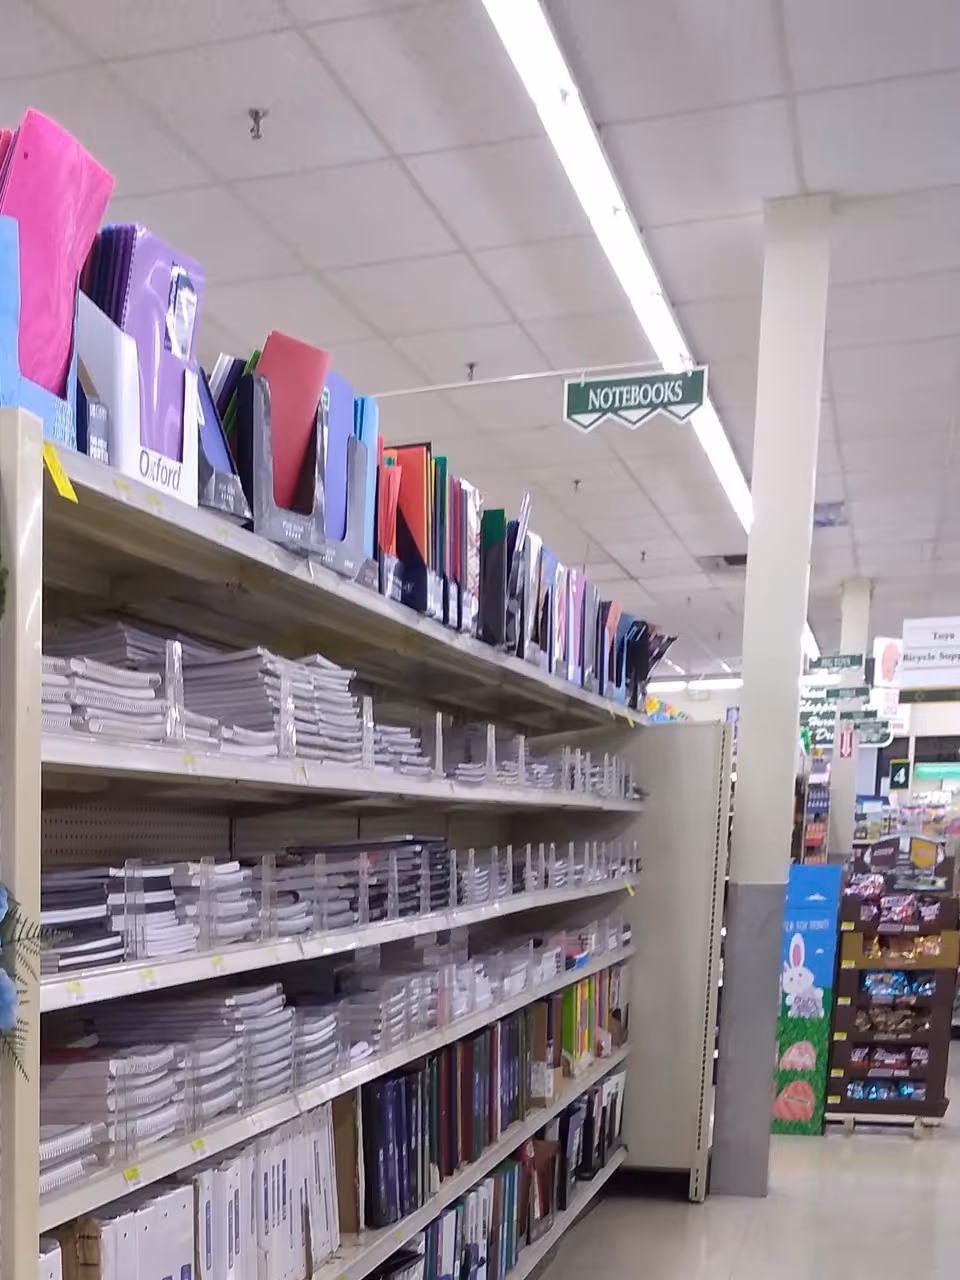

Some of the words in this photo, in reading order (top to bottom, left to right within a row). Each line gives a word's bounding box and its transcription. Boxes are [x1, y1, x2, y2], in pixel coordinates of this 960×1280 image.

[588, 380, 683, 410] NOTEBOOKS
[139, 449, 182, 492] Oxford
[903, 652, 936, 663] Bicycle
[893, 767, 906, 784] 4
